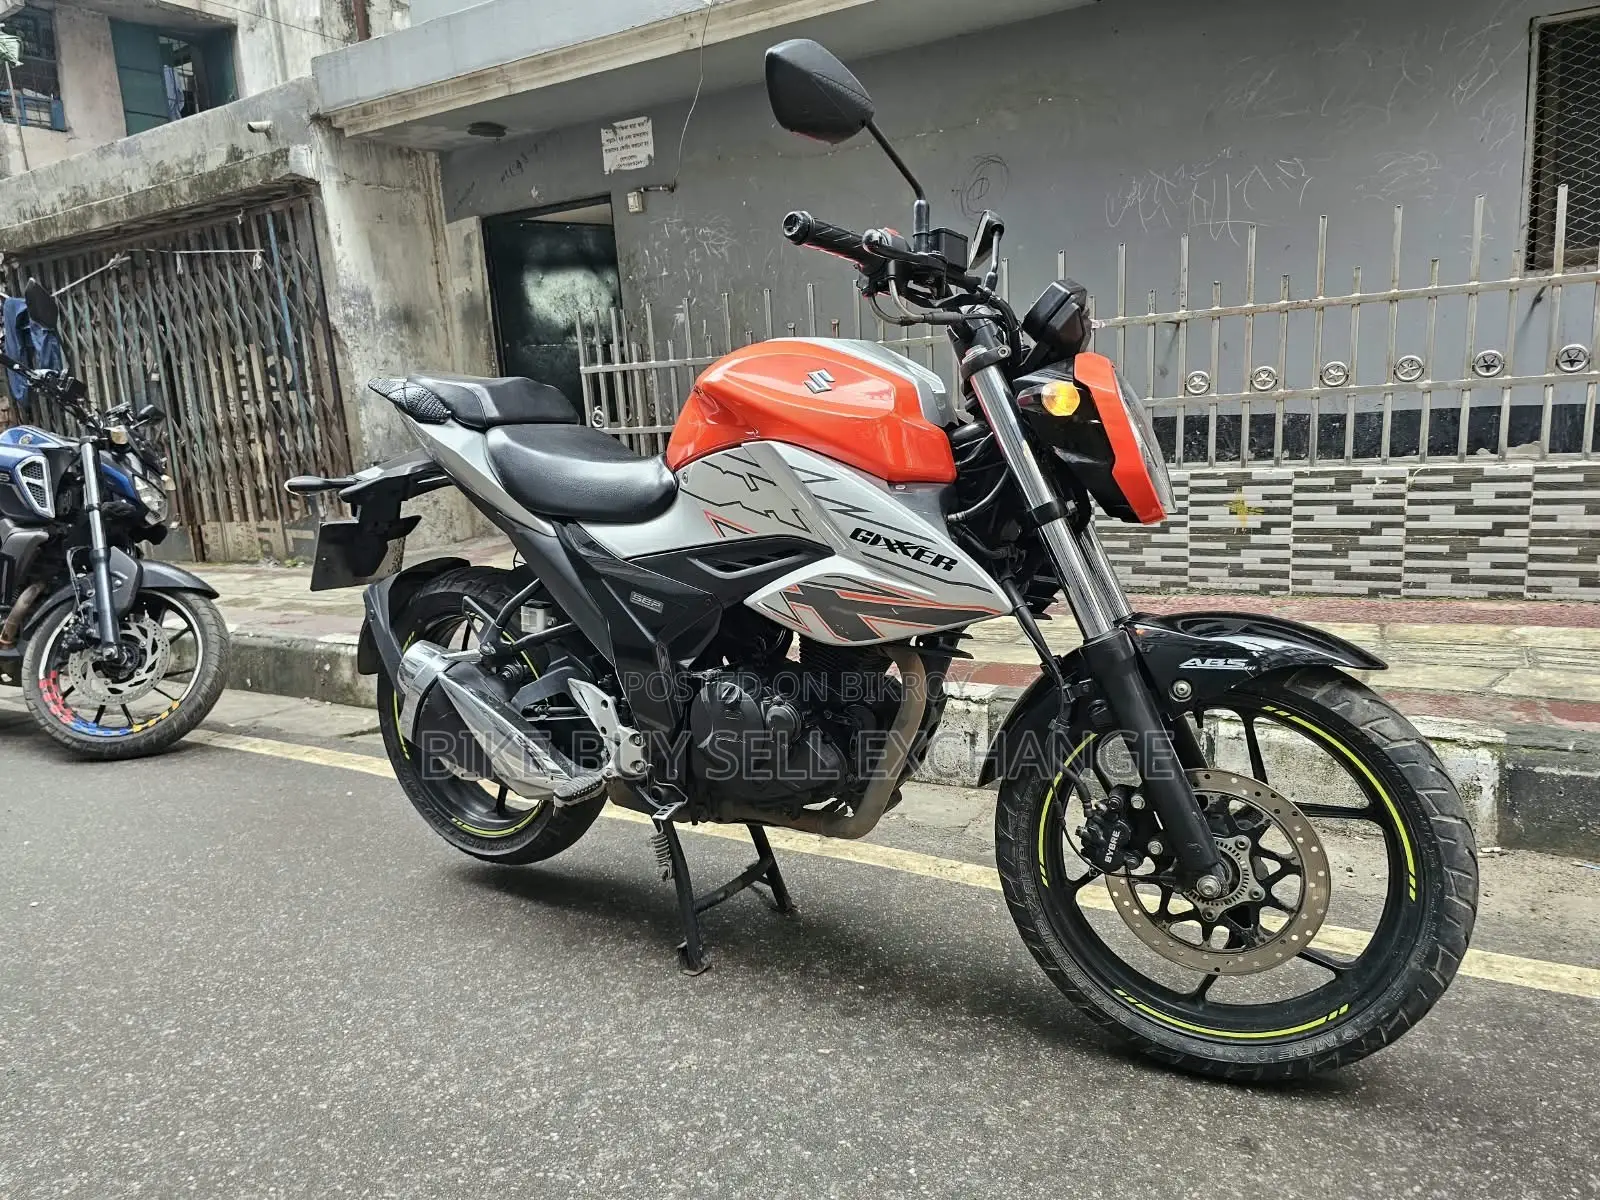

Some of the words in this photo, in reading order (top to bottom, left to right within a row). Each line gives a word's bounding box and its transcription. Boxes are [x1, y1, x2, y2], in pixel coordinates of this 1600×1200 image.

[849, 527, 959, 572] GIXXER
[631, 593, 662, 608] SEP
[1179, 657, 1250, 670] ABS
[1104, 830, 1121, 864] BYBRE
